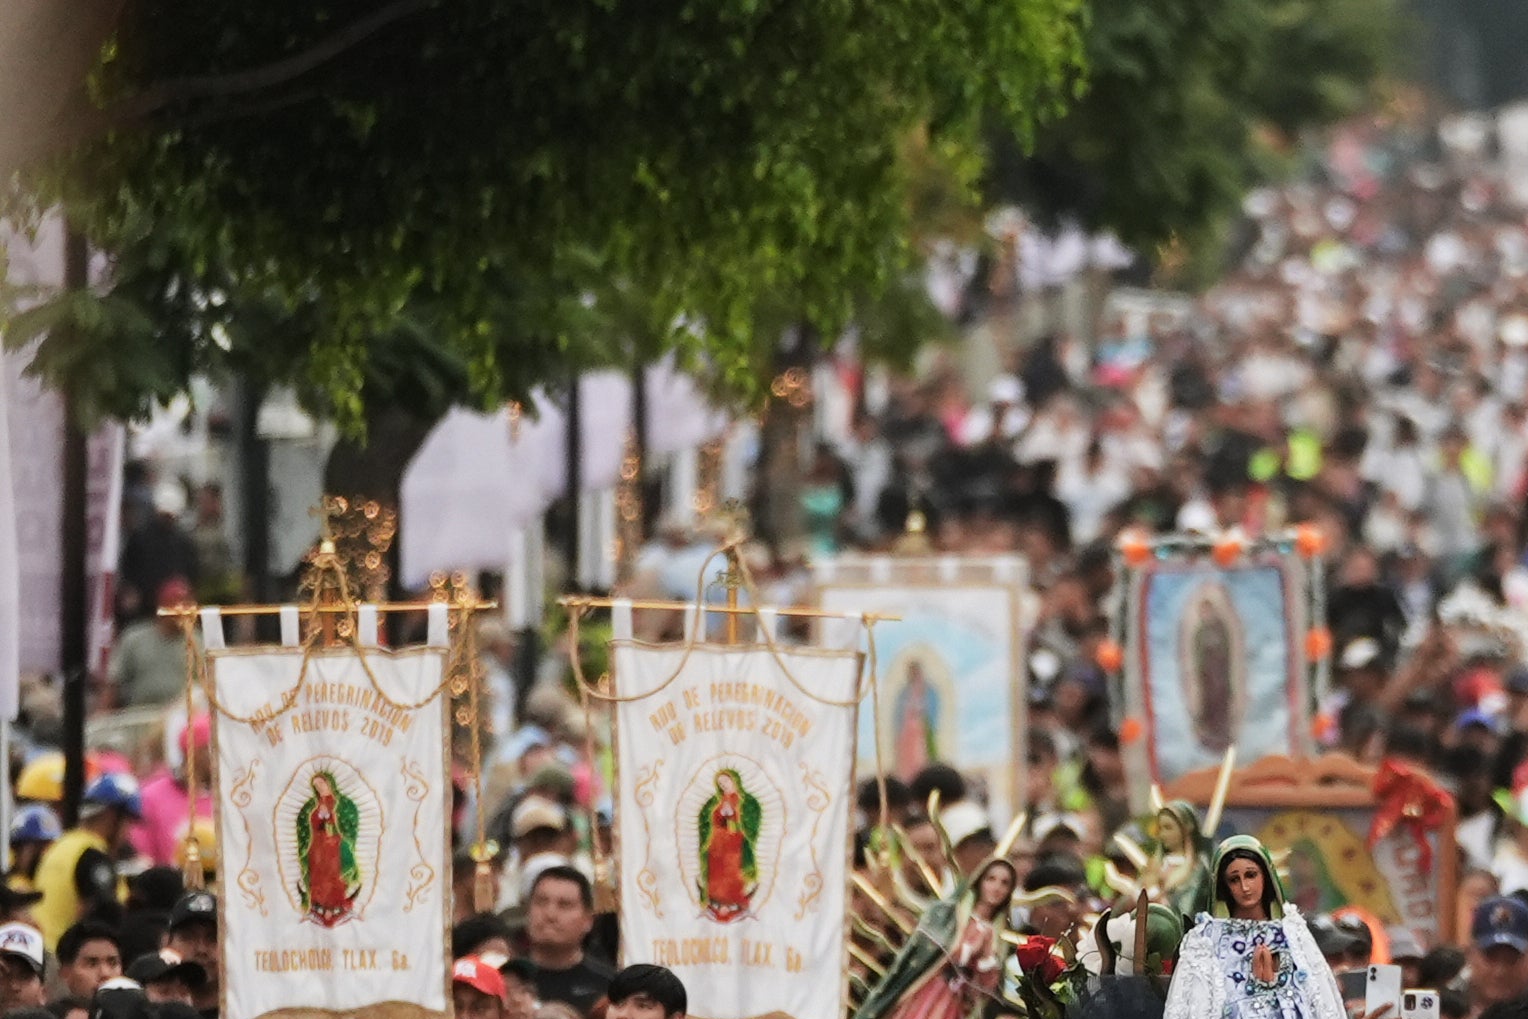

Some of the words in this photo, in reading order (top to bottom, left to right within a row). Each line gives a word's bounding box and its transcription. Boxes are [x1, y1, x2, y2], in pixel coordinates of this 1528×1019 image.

[266, 723, 283, 748] DE
[292, 709, 350, 734] RELEVOS
[361, 716, 394, 747] 2019
[694, 709, 755, 733] RELEVOS
